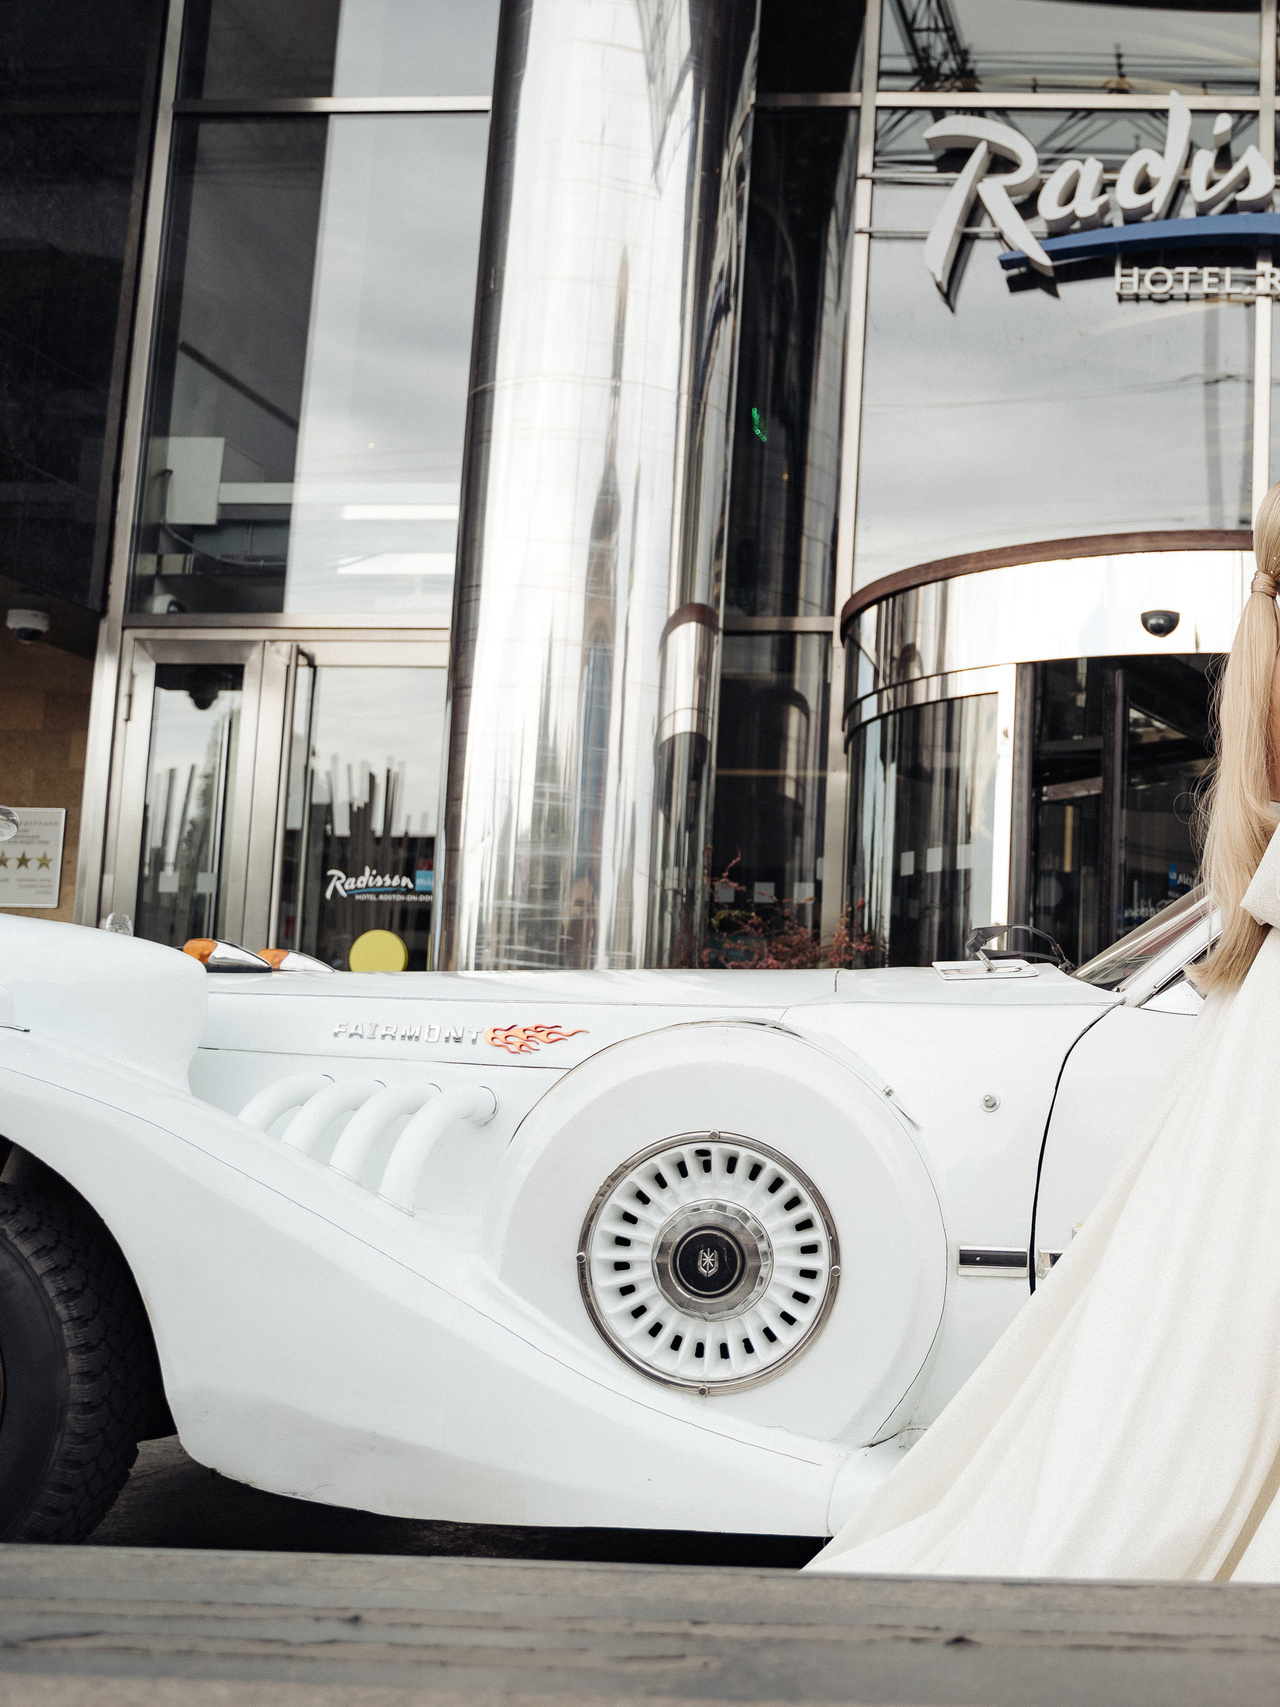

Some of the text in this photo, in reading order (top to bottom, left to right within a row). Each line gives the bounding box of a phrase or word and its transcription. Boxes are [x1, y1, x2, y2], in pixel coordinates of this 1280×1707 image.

[1115, 266, 1252, 295] HOTEL,
[325, 865, 414, 900] Radisson
[333, 1022, 483, 1045] FAIRMONT
